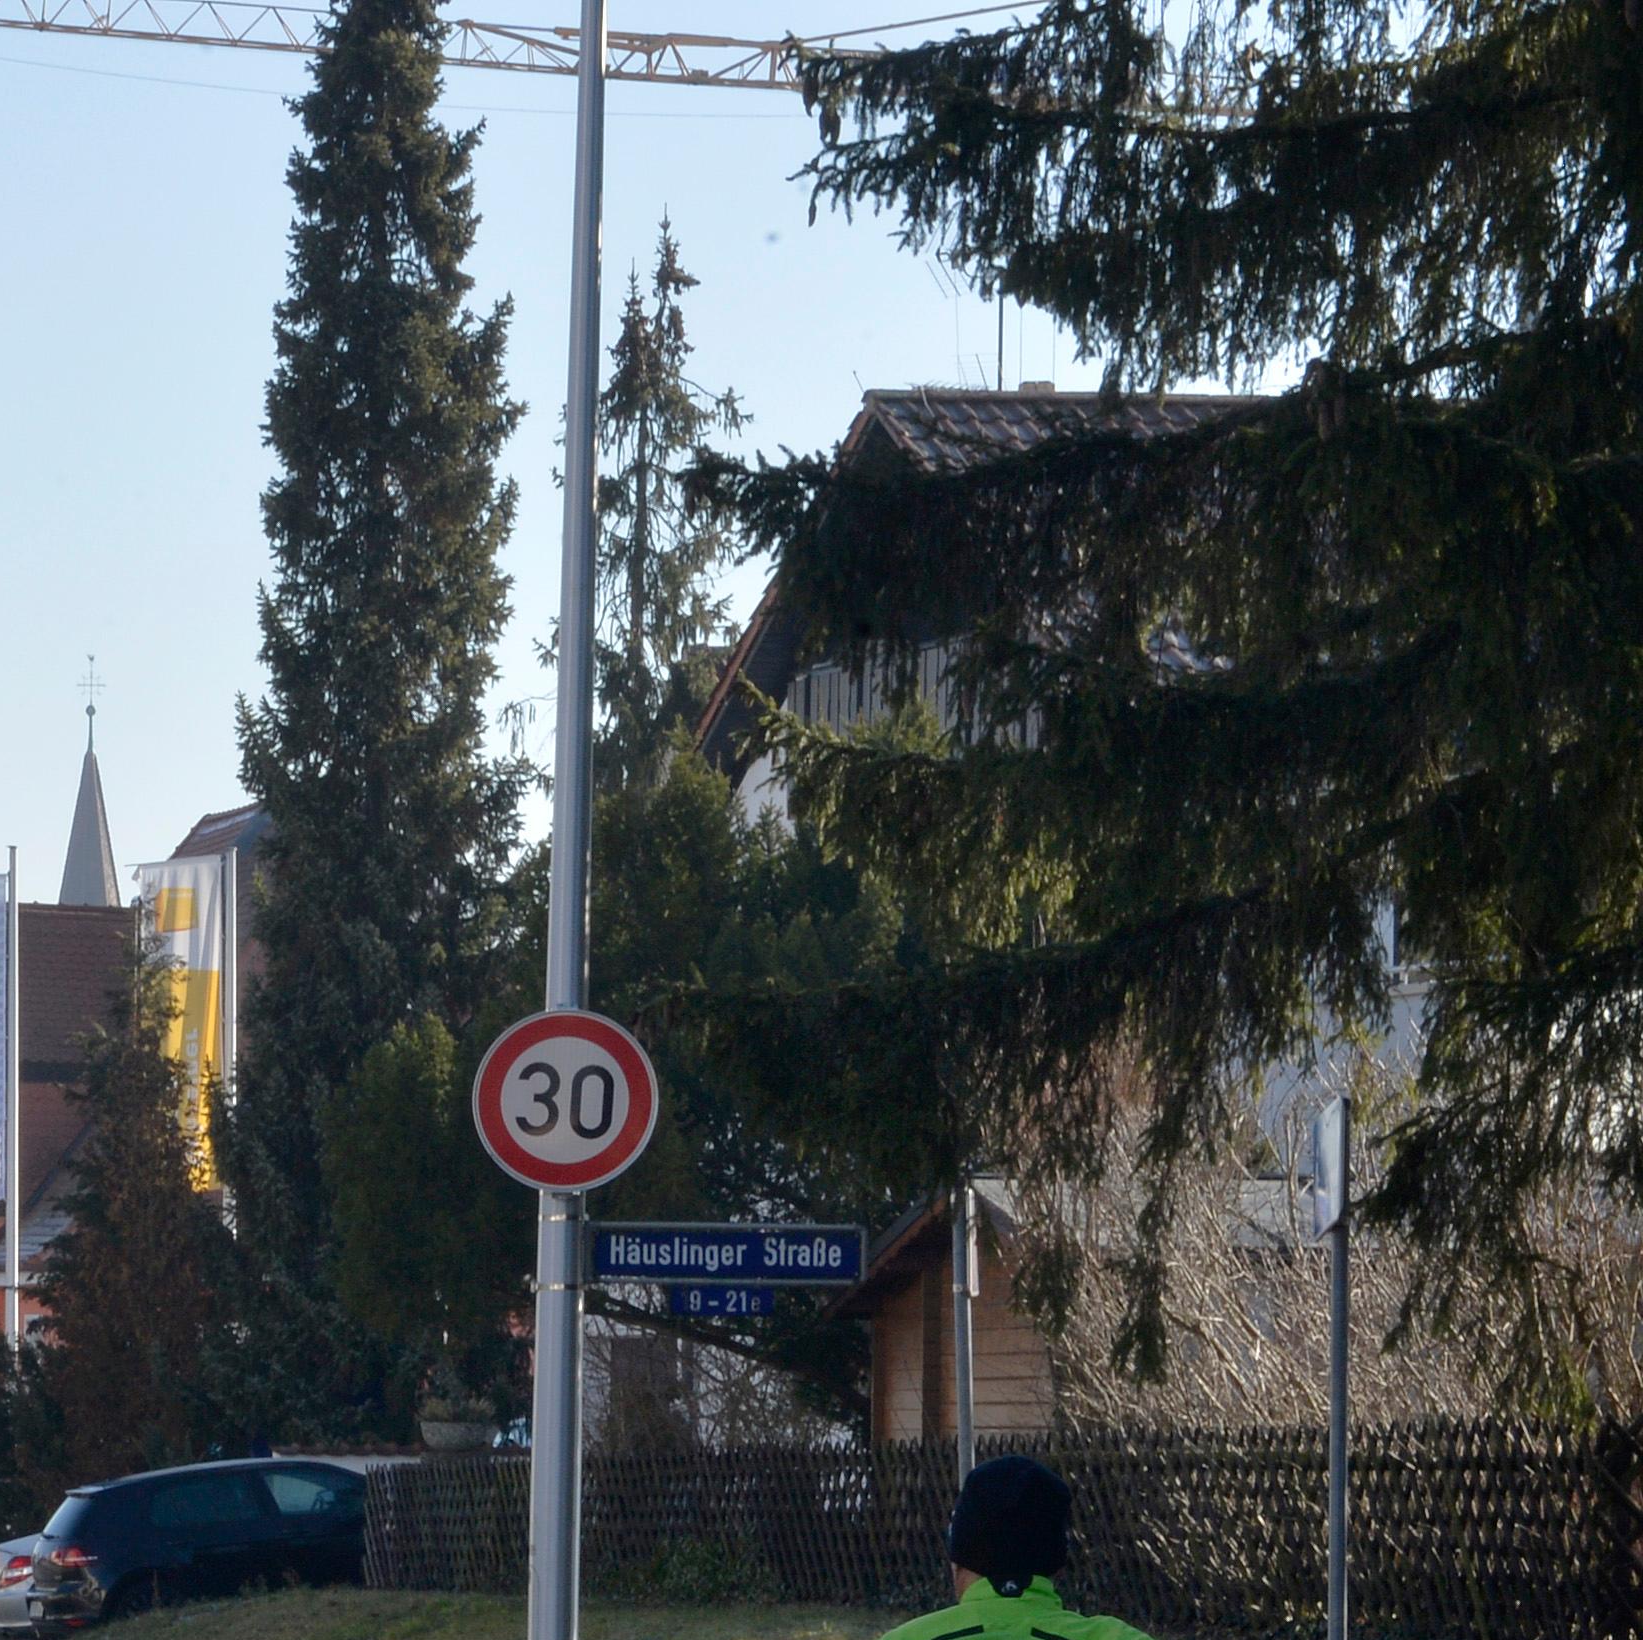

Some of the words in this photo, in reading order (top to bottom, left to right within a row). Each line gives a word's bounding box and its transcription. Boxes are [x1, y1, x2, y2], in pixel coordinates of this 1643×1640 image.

[515, 1062, 614, 1140] 30
[610, 1235, 747, 1272] Häuslinger
[764, 1237, 842, 1268] Straße
[689, 1290, 702, 1312] 9
